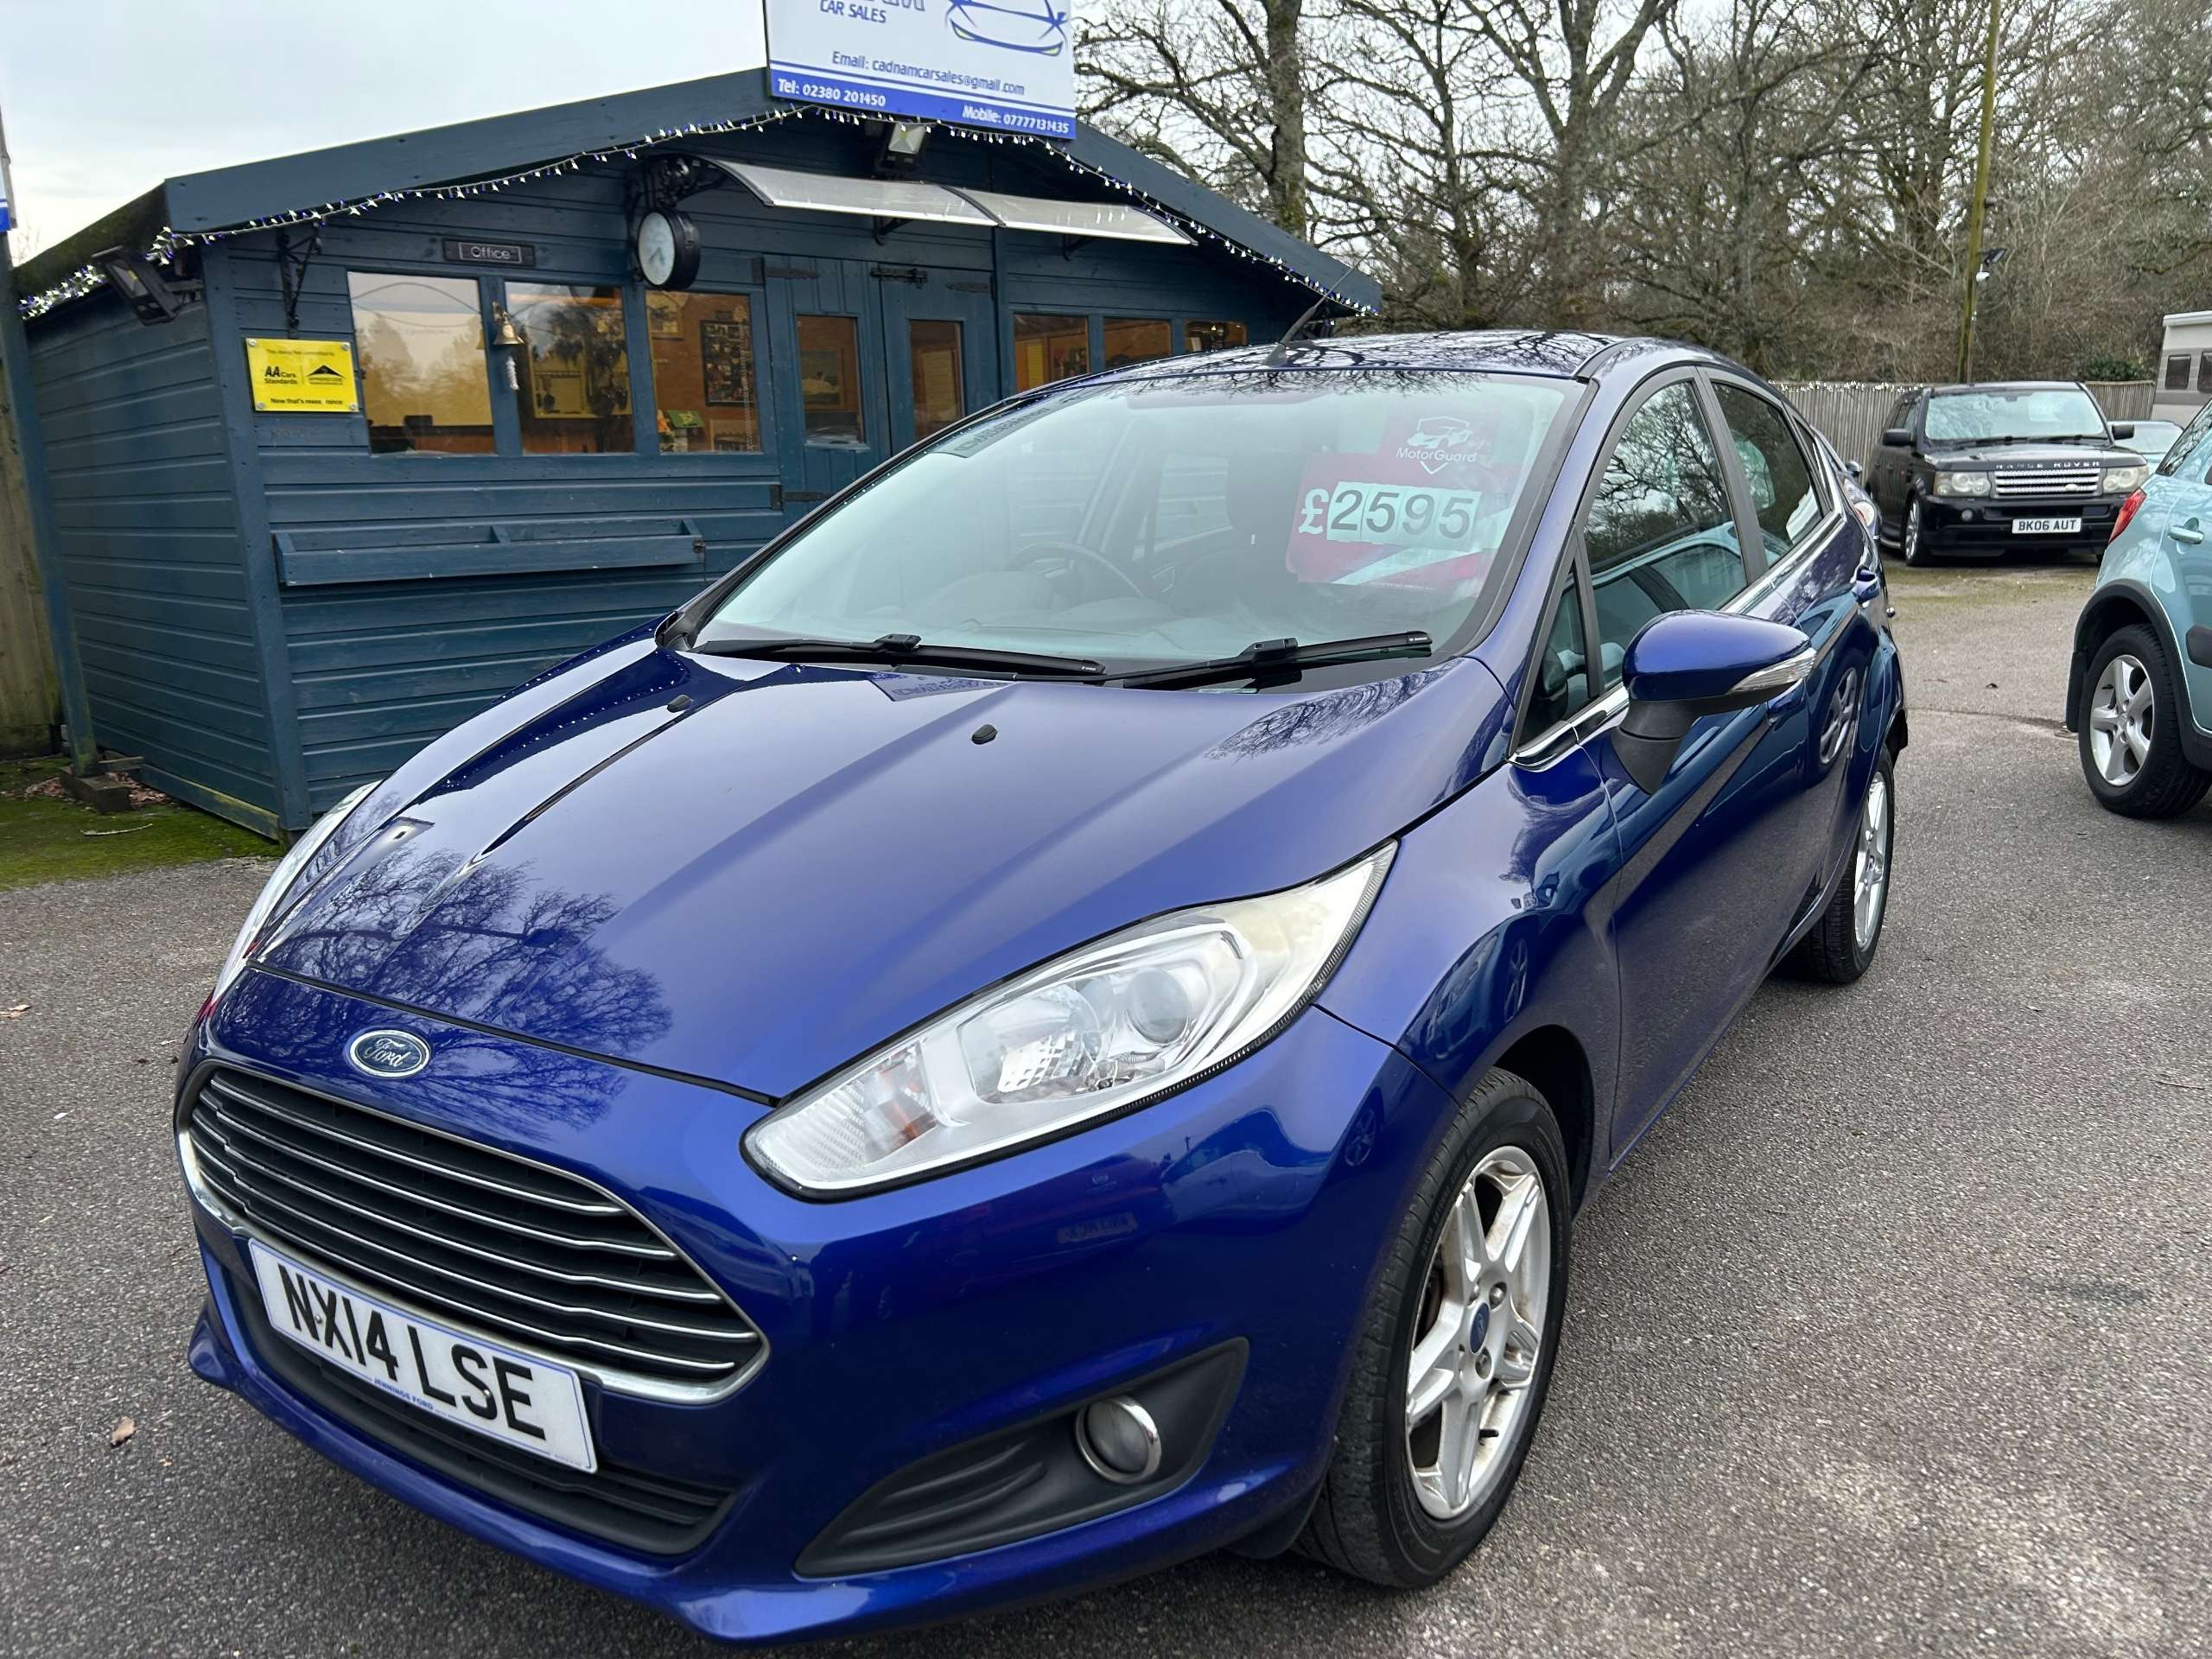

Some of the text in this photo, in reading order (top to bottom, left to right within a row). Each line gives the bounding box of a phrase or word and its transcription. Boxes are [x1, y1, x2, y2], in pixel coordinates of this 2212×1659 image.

[820, 0, 844, 16] CAR
[849, 3, 887, 23] SALES
[832, 51, 1025, 95] Email: cadnamcarsales@gmail.com
[778, 79, 887, 106] Tel: 02380 201450
[962, 105, 1069, 134] Mobile: 07777131435
[470, 245, 512, 259] Office
[264, 365, 281, 378] AA
[1395, 447, 1478, 463] MotorGuard
[1298, 487, 1474, 539] £2595
[2018, 519, 2077, 531] BK06 AUT
[365, 1038, 411, 1067] Ford
[277, 1263, 547, 1441] NX14 LSE
